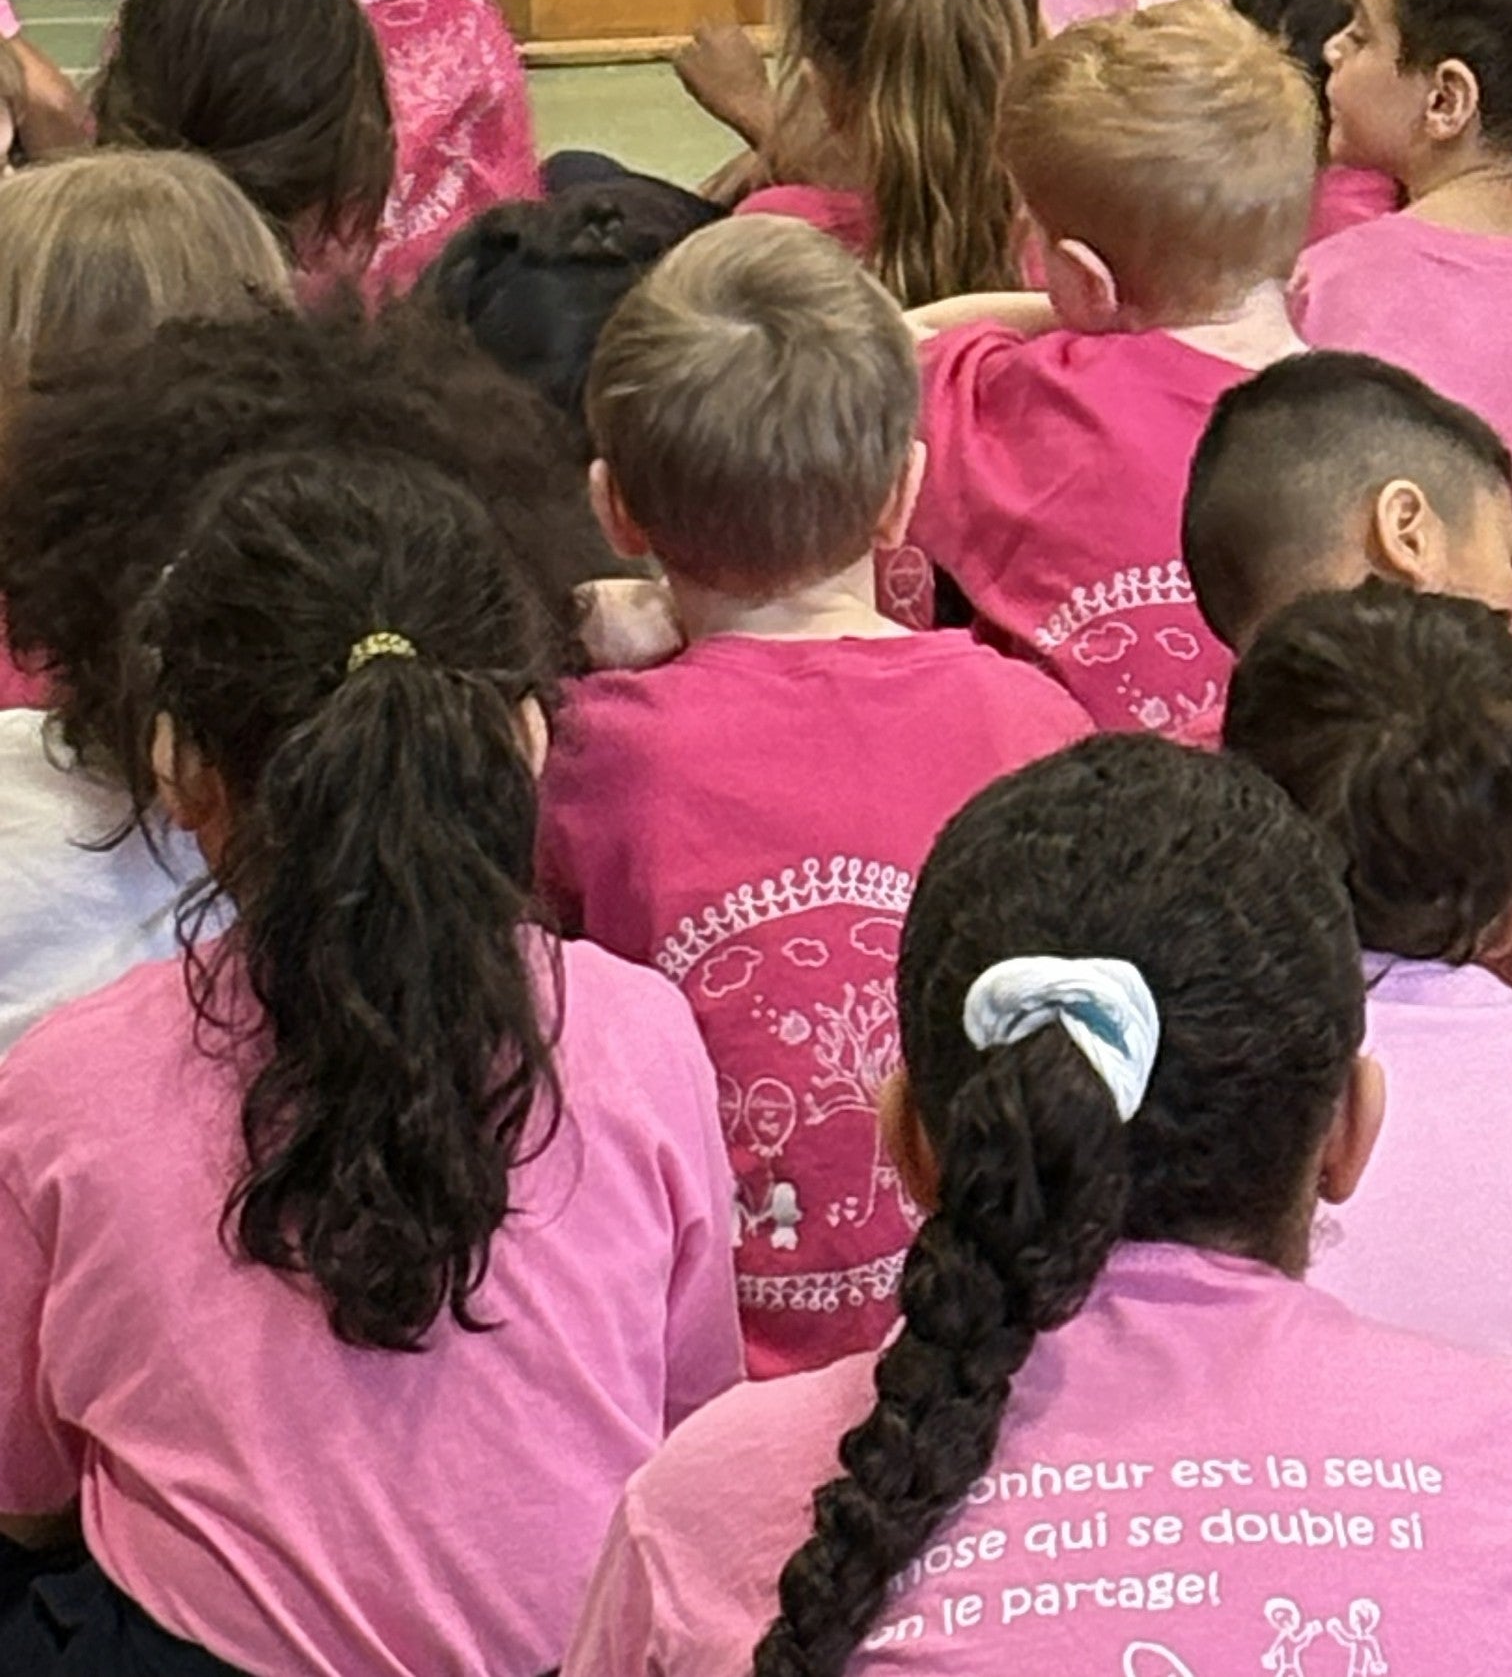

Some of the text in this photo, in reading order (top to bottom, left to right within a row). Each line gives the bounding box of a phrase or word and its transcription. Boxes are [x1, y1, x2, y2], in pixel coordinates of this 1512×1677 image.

[962, 1453, 1443, 1506] onheur est la seule
[890, 1507, 1424, 1592] hose qui se double si
[942, 1592, 984, 1636] le
[1001, 1570, 1222, 1625] partage!
